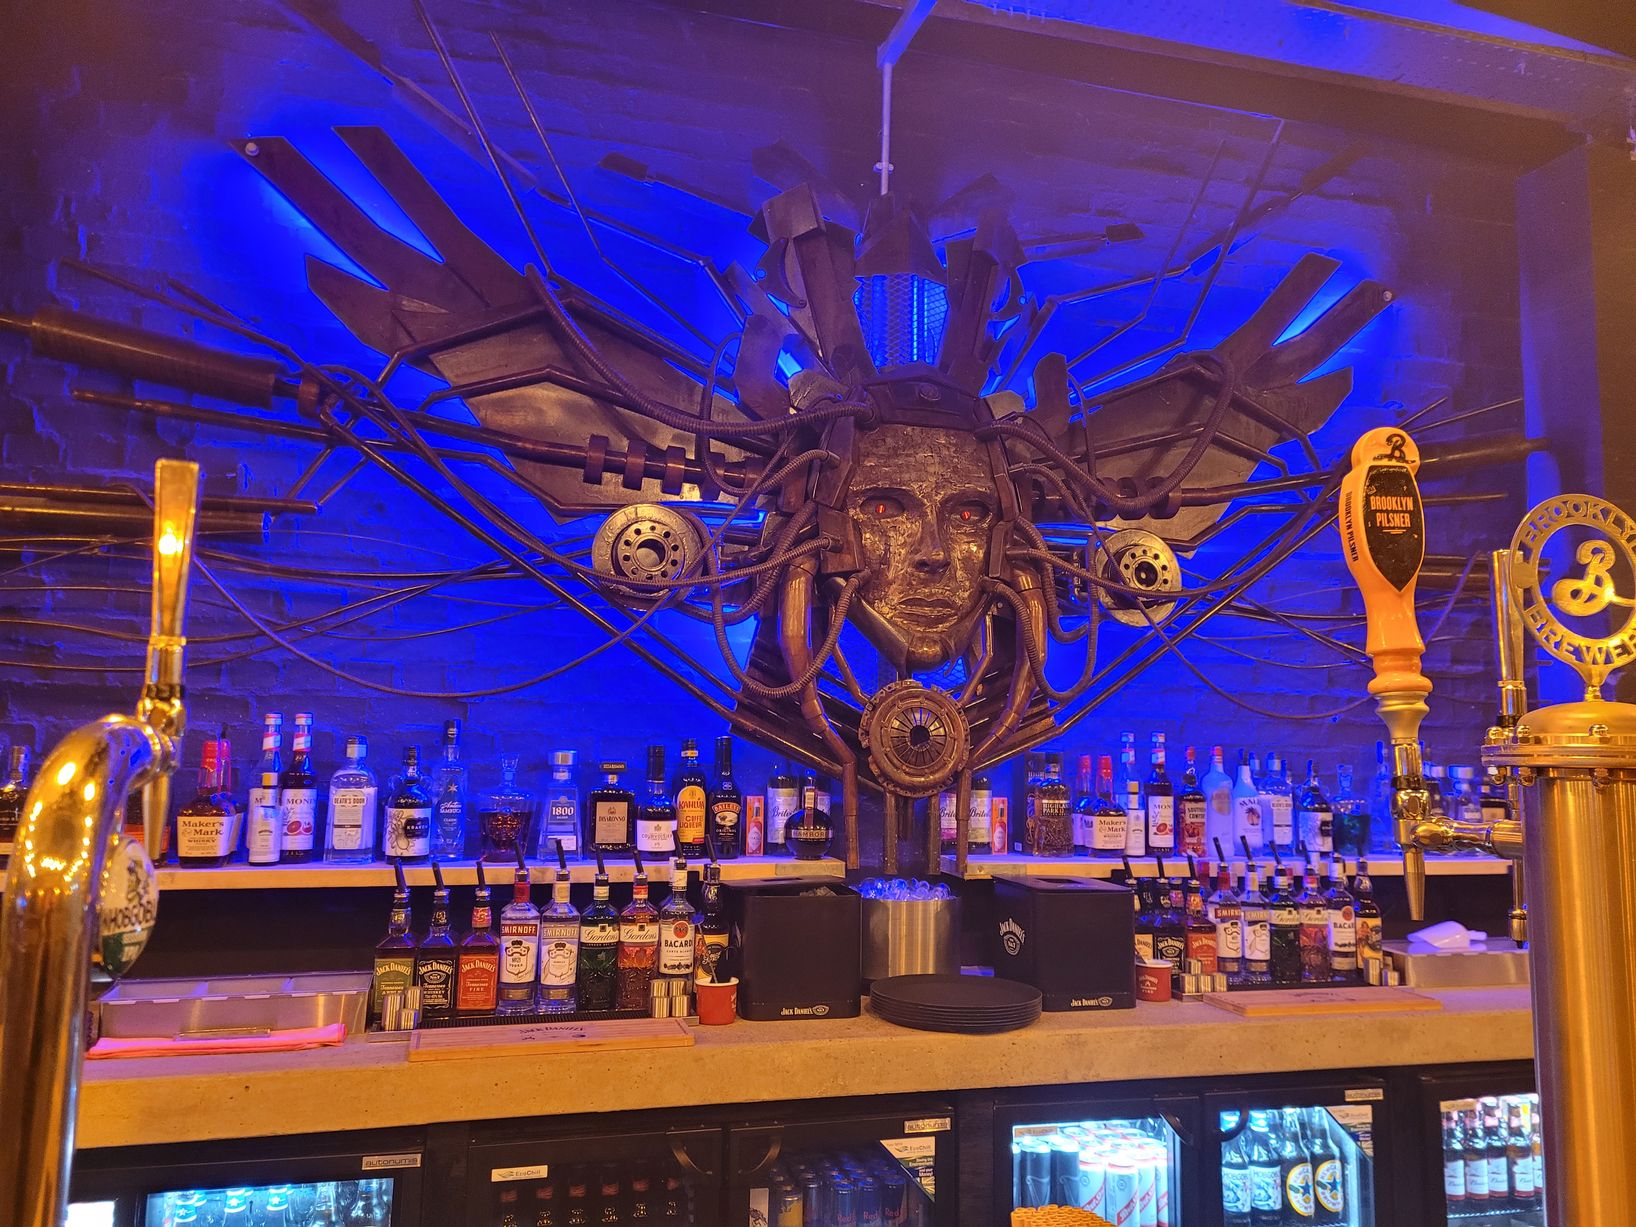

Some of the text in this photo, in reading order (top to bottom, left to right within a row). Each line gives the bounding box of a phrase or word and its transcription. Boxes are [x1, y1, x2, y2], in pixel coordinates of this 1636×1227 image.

[1370, 495, 1414, 511] BROOKLYN
[1344, 491, 1353, 531] BROOKLYN
[1375, 512, 1411, 527] PILSNER
[1347, 530, 1359, 562] PILSNER
[552, 806, 574, 816] 1800
[181, 820, 225, 828] Maker's
[193, 828, 225, 836] Mark
[501, 925, 536, 934] SMIRNOFF
[543, 927, 577, 938] SMIRNOFF
[999, 917, 1025, 944] JACK DANIEL'S
[1157, 941, 1168, 950] JACK
[376, 962, 412, 976] JACK DANIEL'S
[419, 962, 454, 975] JACK DANIEL'S
[461, 959, 496, 973] JACK DANIEL'S
[1070, 998, 1099, 1007] JACK DANIEL'S
[780, 1007, 814, 1016] JACK DANIEL'S
[863, 1210, 878, 1220] Red
